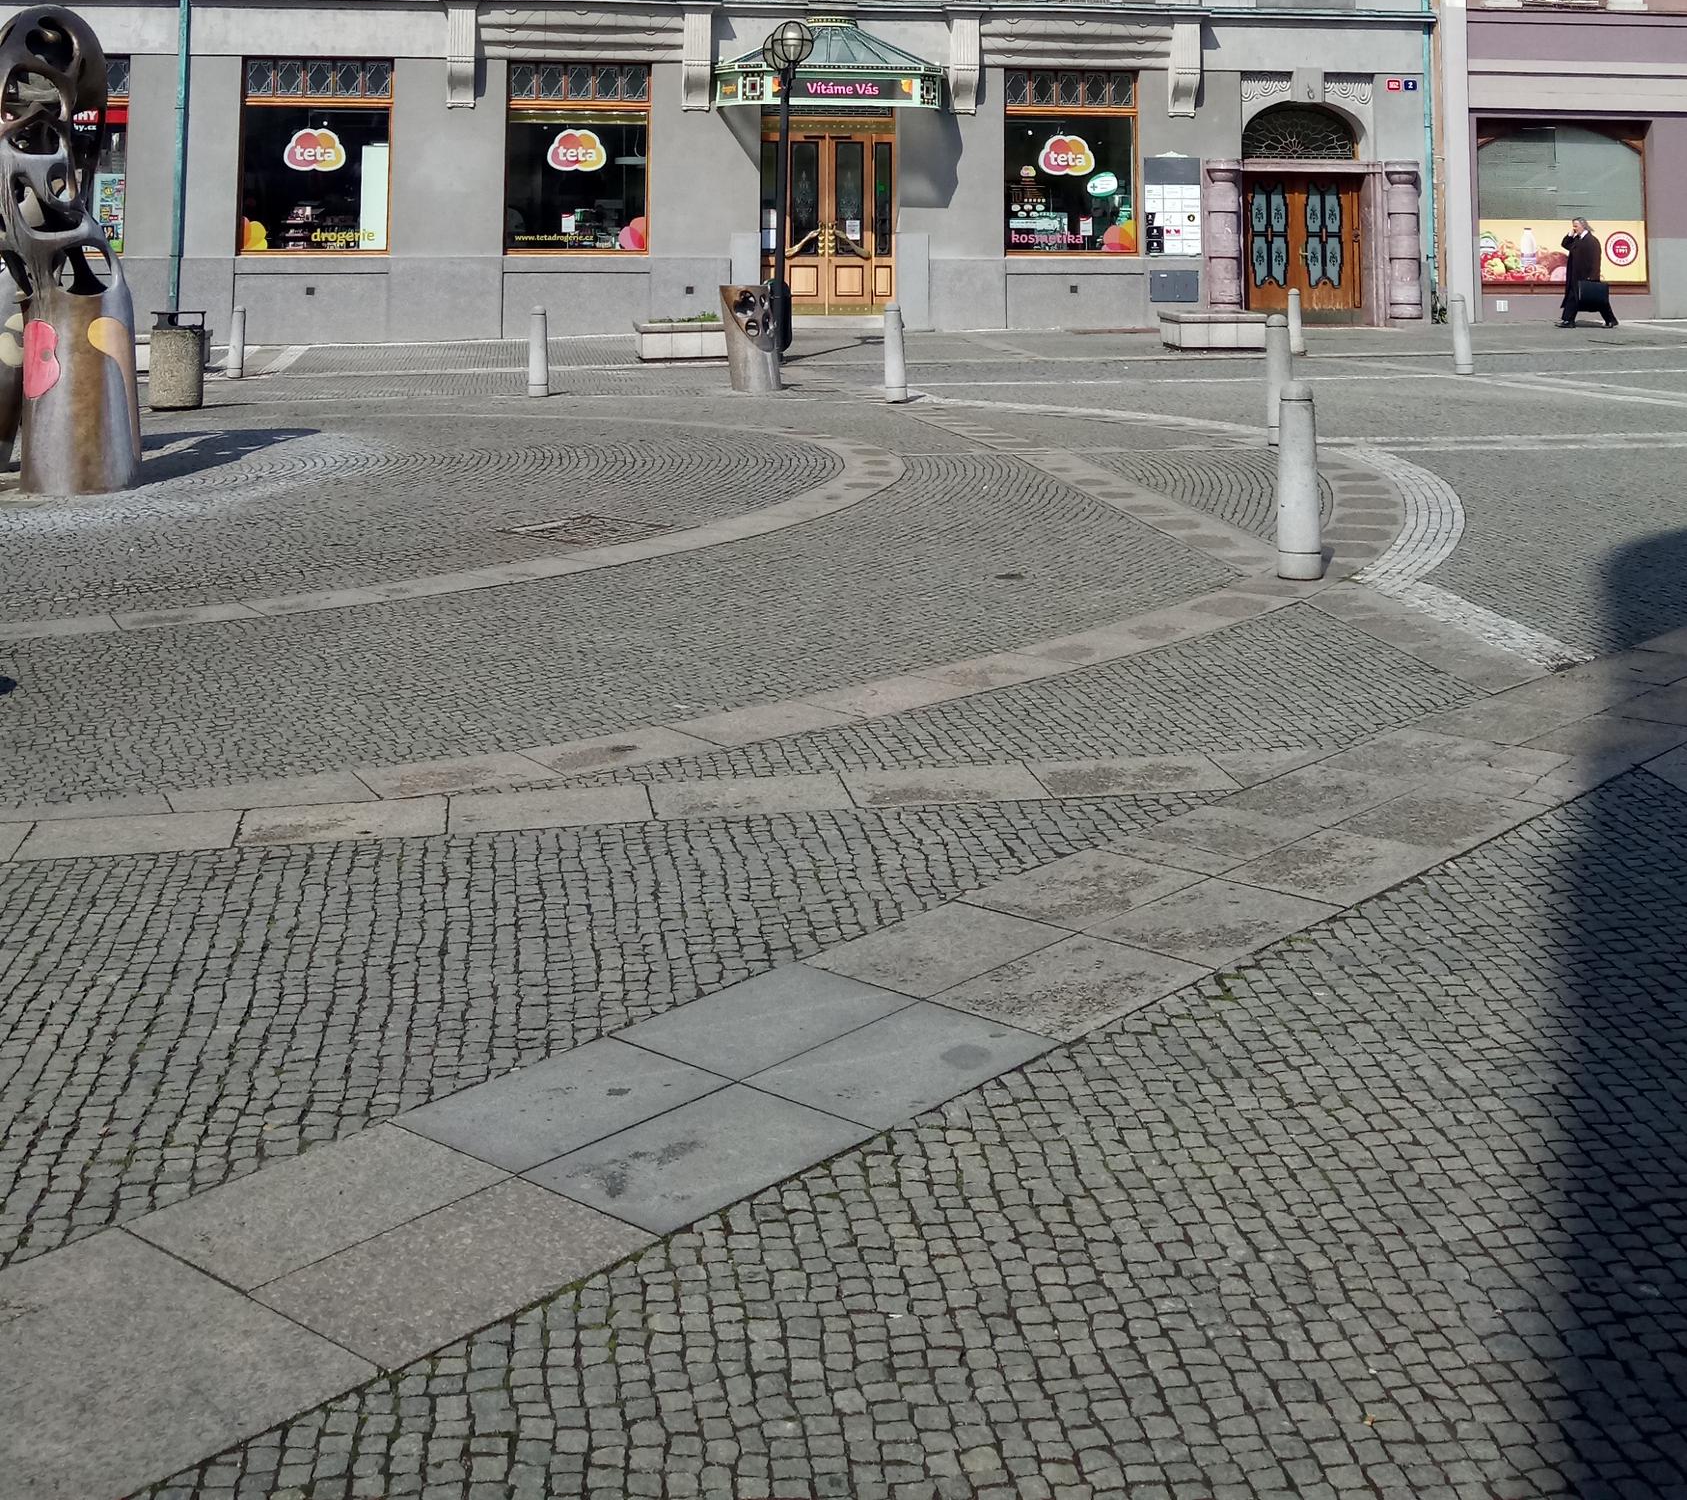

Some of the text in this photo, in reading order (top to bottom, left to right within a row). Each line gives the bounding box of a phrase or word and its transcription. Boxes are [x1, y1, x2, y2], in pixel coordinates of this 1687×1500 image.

[806, 81, 880, 95] Vítáme Vás
[295, 145, 337, 161] teta
[558, 145, 597, 161] teta
[1049, 151, 1086, 166] teta
[311, 228, 375, 244] drogerie
[514, 233, 594, 243] www.tetadrogerie.cz
[1011, 230, 1084, 244] kosmetika
